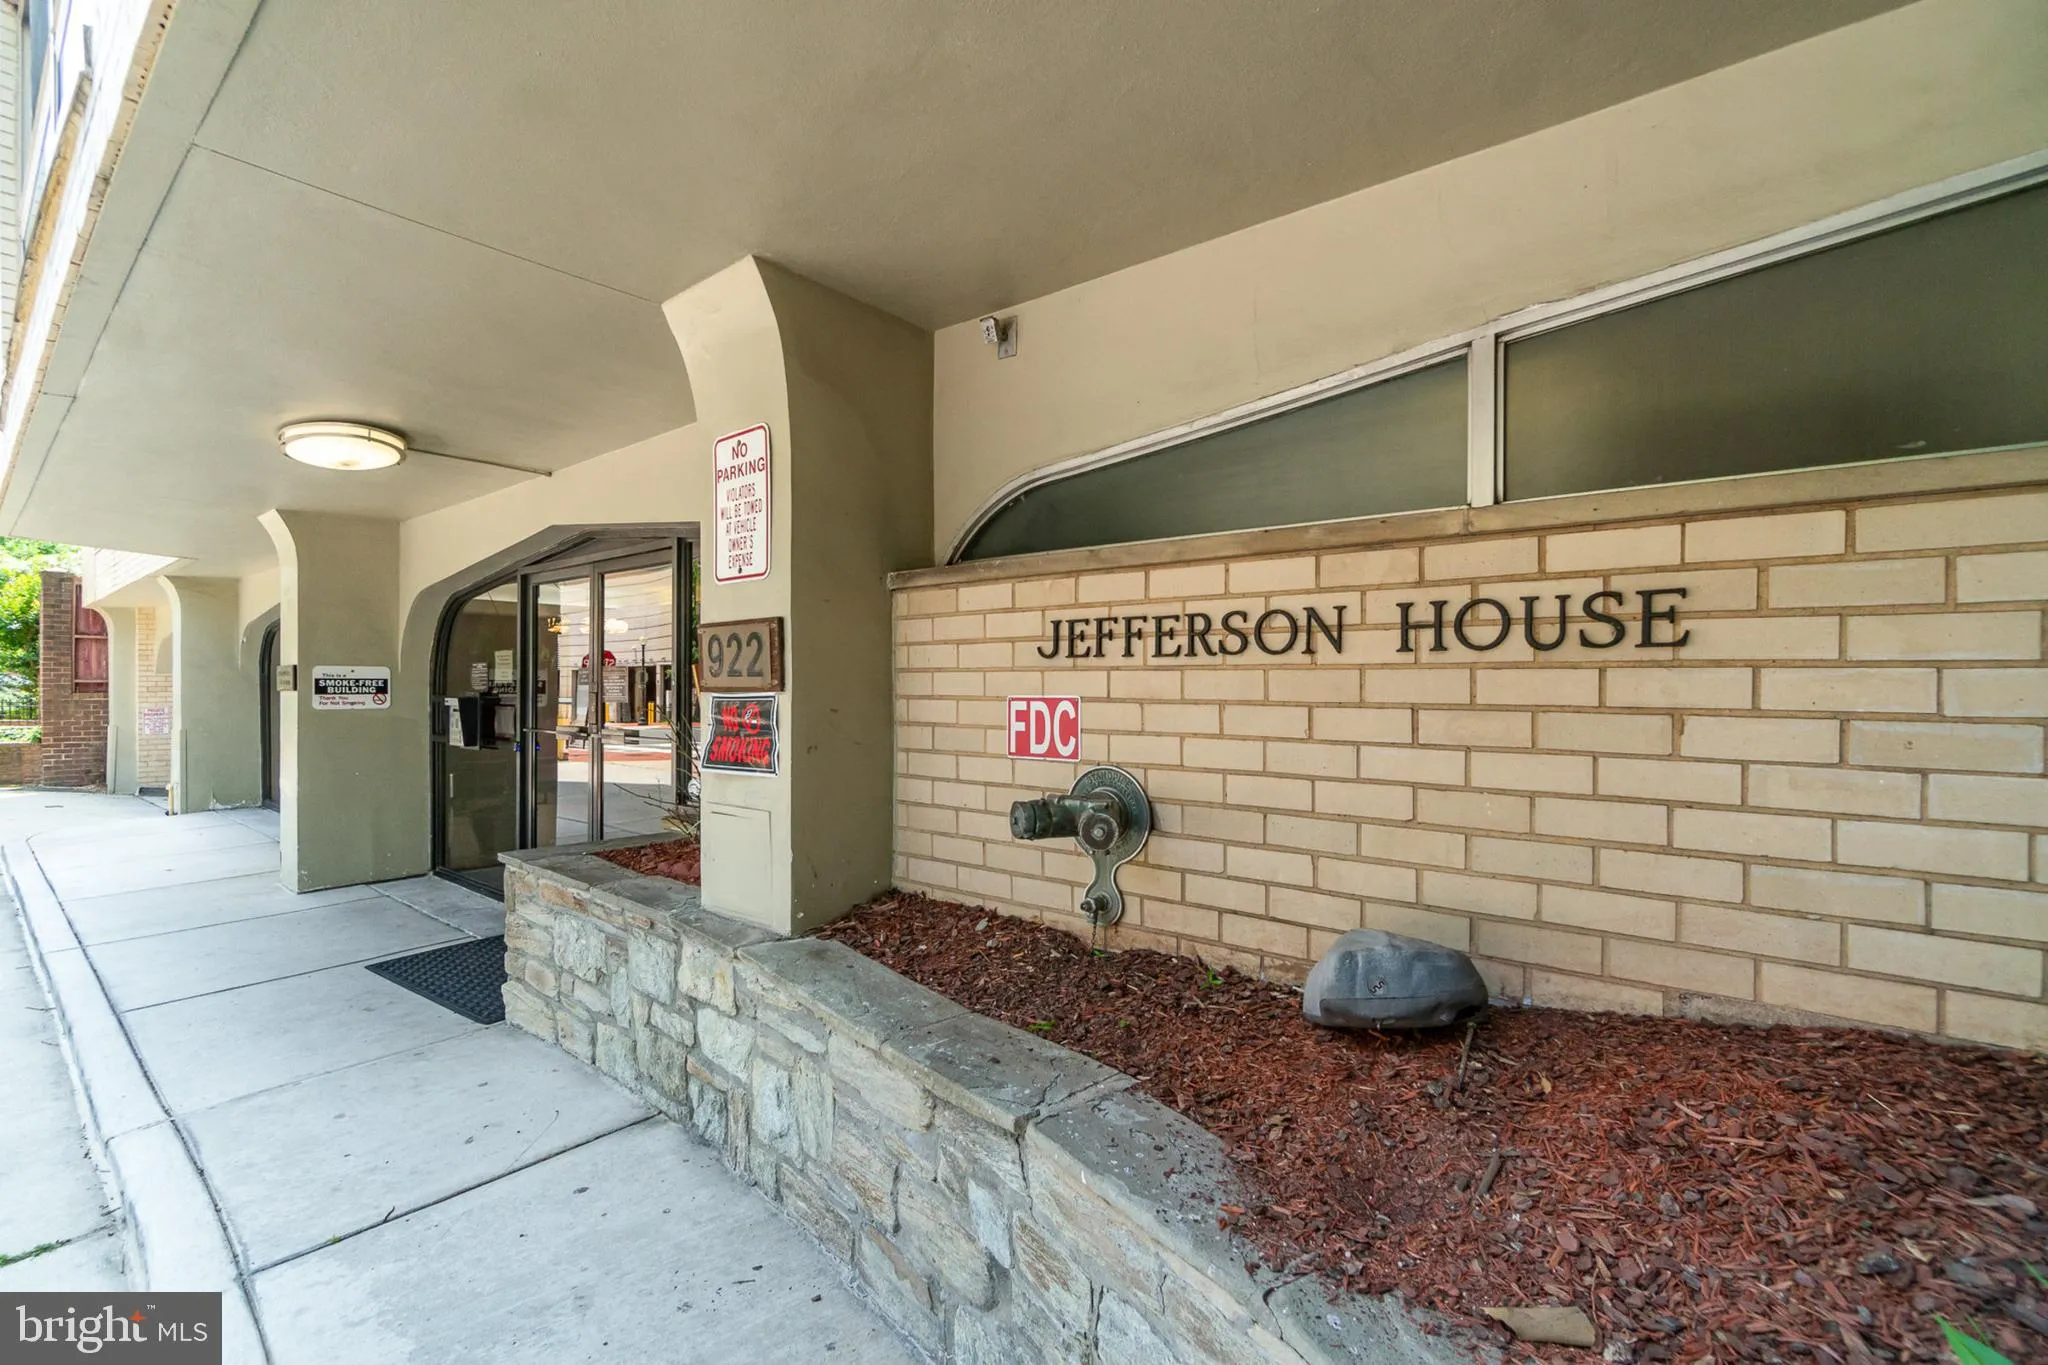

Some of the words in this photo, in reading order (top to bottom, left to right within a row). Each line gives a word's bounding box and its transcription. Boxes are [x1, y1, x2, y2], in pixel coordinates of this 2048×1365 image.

[732, 442, 747, 460] NO
[717, 457, 765, 483] PARKING
[726, 483, 755, 501] VIOLATORS
[721, 506, 732, 520] WILL
[734, 503, 742, 517] BE
[744, 498, 763, 516] TOWED
[734, 517, 756, 534] VEHICLE
[729, 552, 753, 569] EXPENSE
[1037, 605, 1347, 659] JEFFERSON
[1396, 588, 1690, 652] HOUSE
[708, 632, 764, 678] 922
[722, 704, 739, 732] NO
[1010, 700, 1076, 756] FDC
[710, 735, 770, 766] SMOKING
